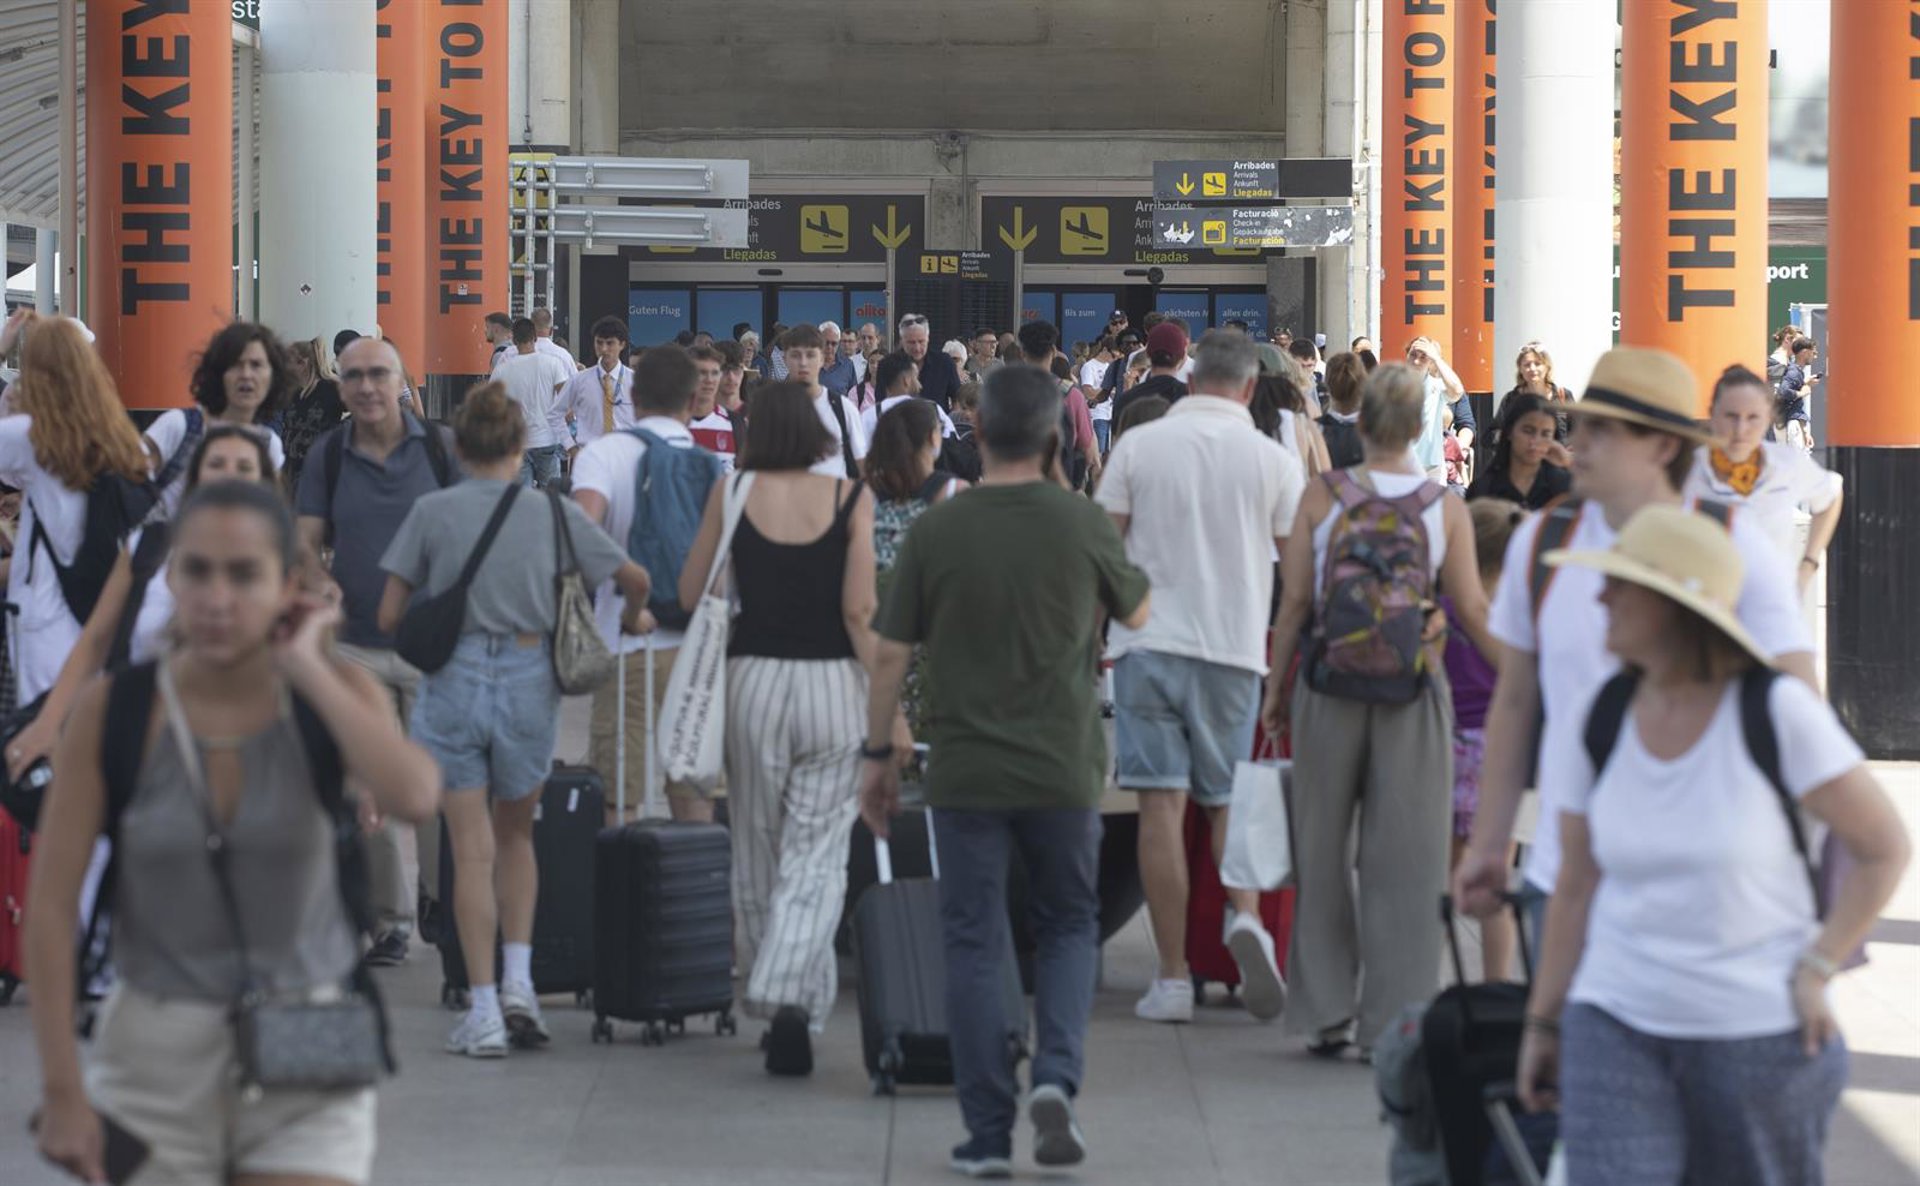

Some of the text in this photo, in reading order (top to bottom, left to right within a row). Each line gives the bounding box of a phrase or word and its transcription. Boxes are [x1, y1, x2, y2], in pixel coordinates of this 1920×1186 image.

[231, 0, 260, 18] st
[440, 22, 484, 88] TO
[1404, 32, 1445, 98] TO
[122, 0, 190, 315] THE KEY
[440, 103, 482, 200] KEY
[1233, 161, 1276, 169] Arribades
[1404, 113, 1445, 211] KEY
[1668, 0, 1738, 321] THE KEY
[1233, 188, 1273, 198] Llegadas
[1233, 209, 1279, 217] Facturació
[1134, 234, 1153, 245] Ank
[1233, 236, 1286, 245] Facturación
[723, 249, 777, 261] Llegadas
[1135, 251, 1189, 263] Llegadas
[440, 218, 482, 314] THE
[1766, 263, 1809, 283] port
[1404, 228, 1445, 324] THE
[629, 305, 681, 318] Guten Flug
[1164, 309, 1200, 318] nächsten
[1222, 309, 1241, 317] alles
